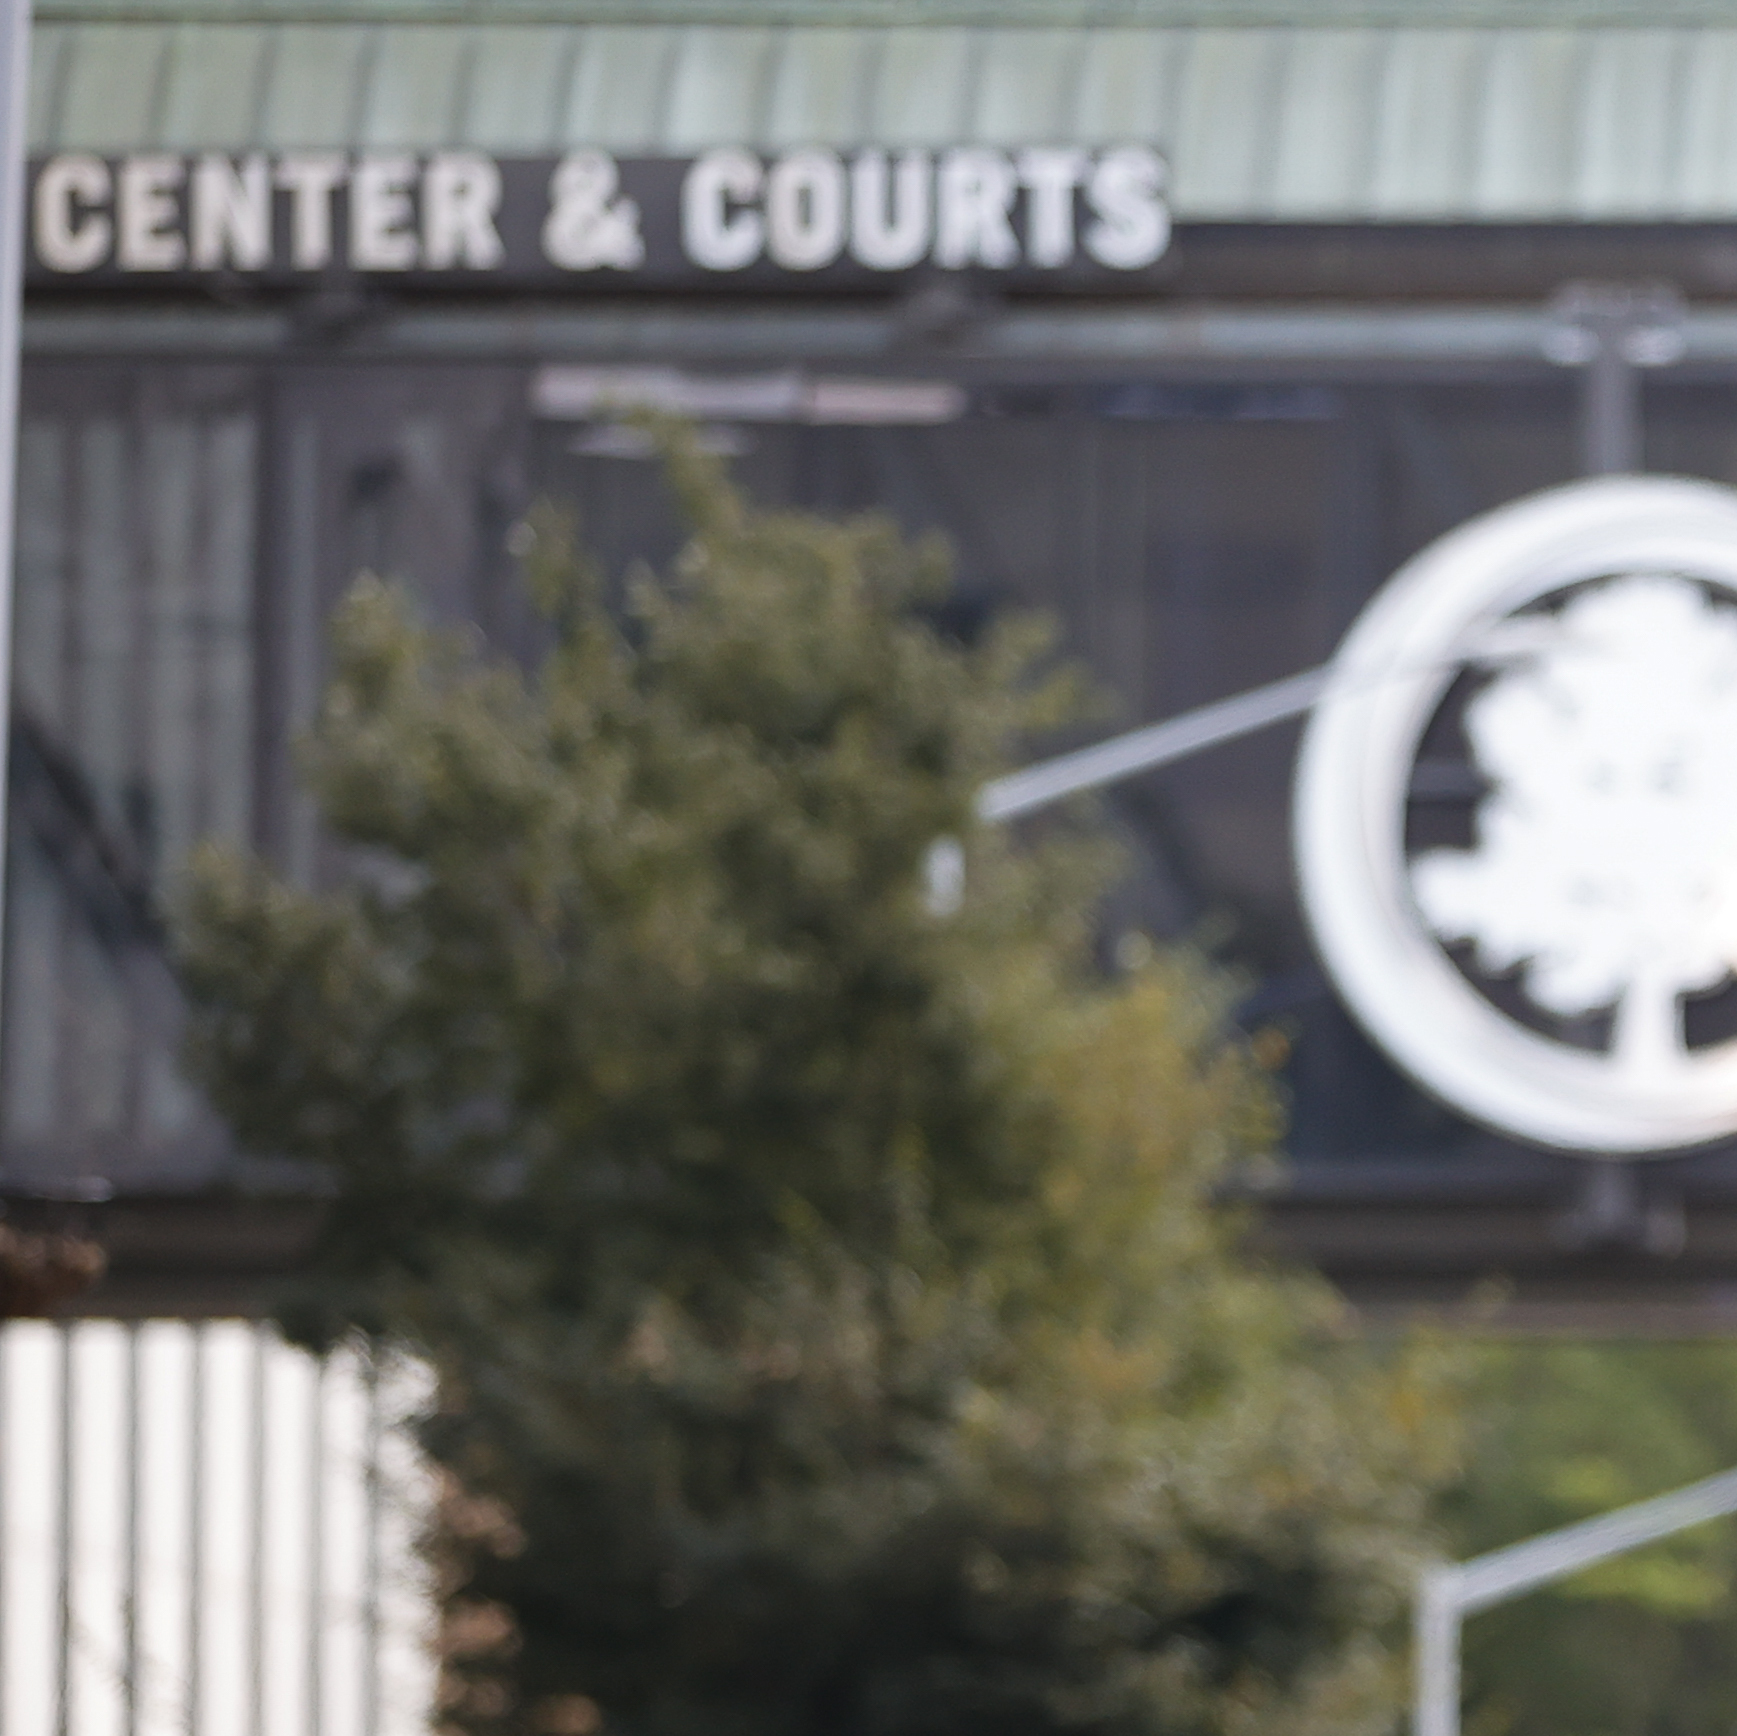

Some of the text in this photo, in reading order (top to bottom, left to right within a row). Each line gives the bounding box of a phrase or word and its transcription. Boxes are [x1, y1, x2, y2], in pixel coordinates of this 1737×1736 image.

[34, 144, 1172, 273] CENTER & COURTS
